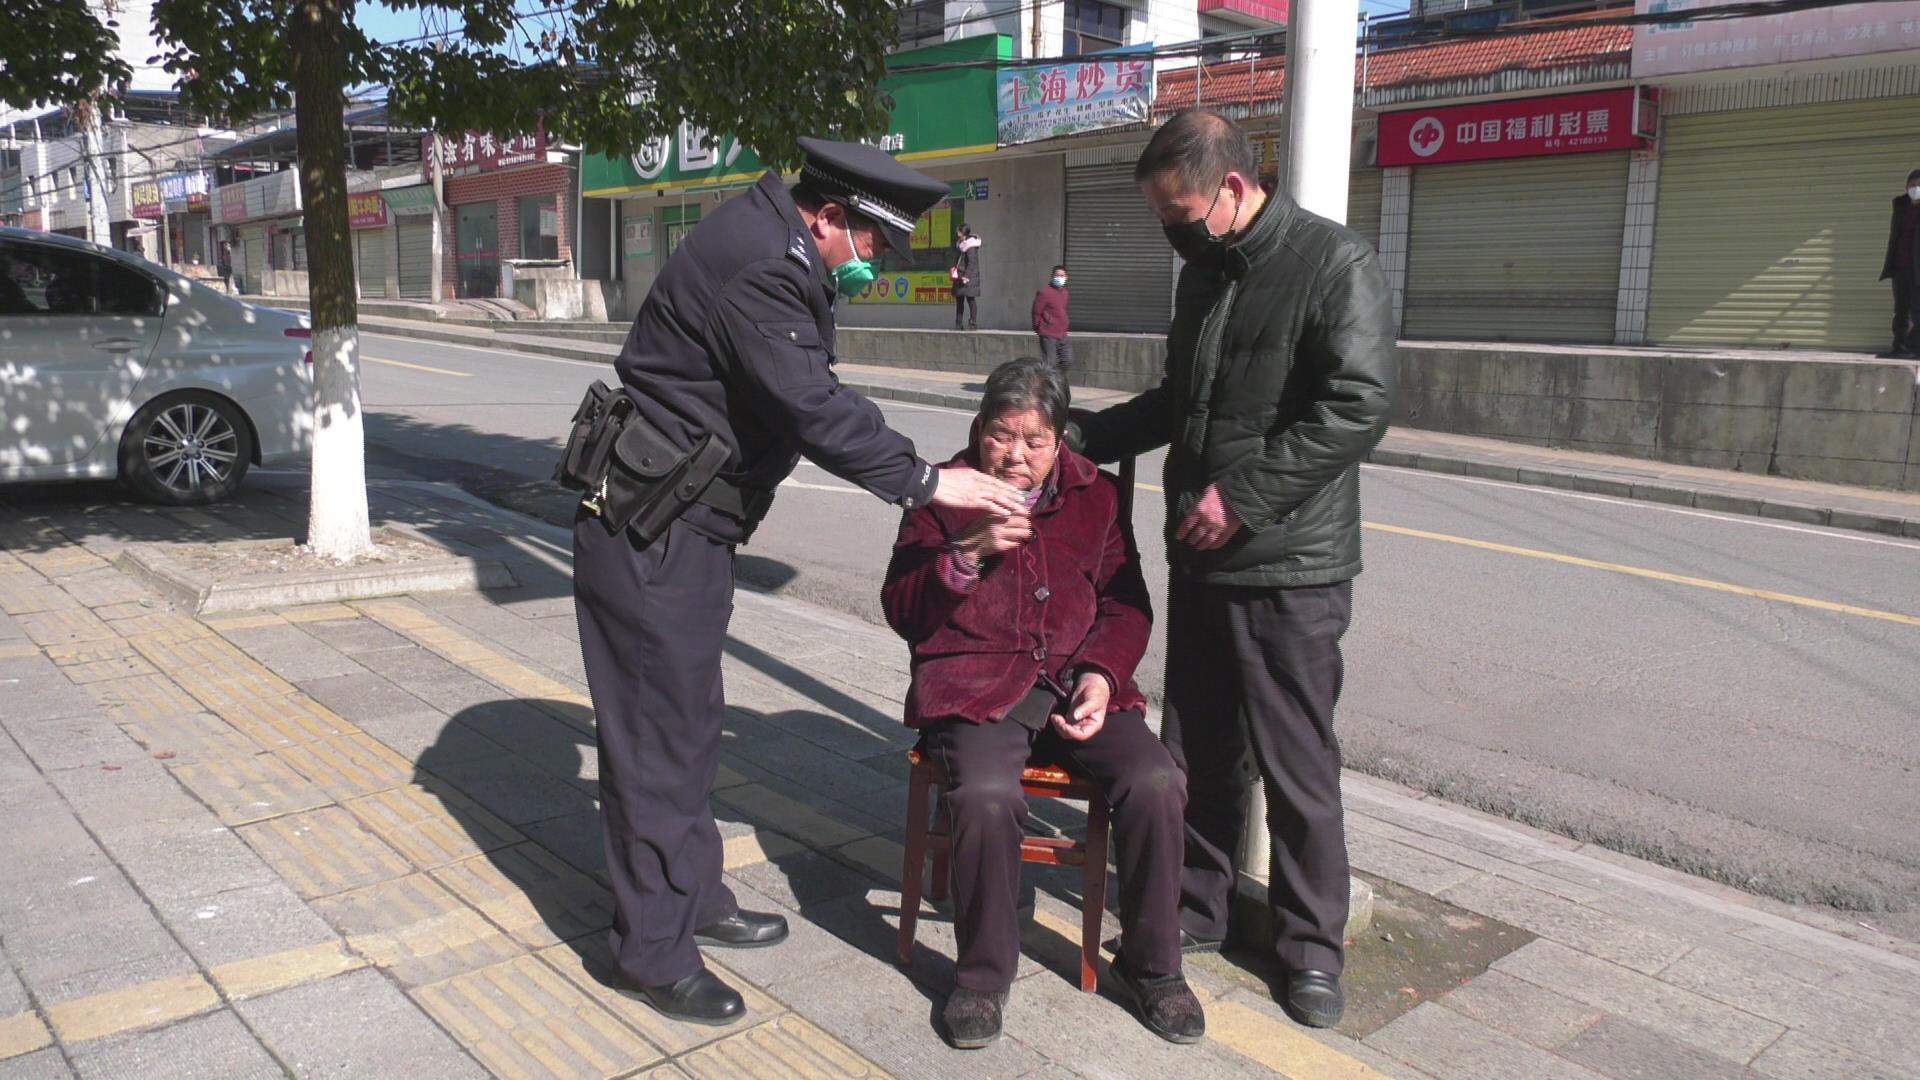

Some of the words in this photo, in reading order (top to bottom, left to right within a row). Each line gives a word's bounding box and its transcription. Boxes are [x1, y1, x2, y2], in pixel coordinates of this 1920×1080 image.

[1008, 60, 1145, 114] 上海炒货
[1456, 109, 1609, 145] 中国福利彩票
